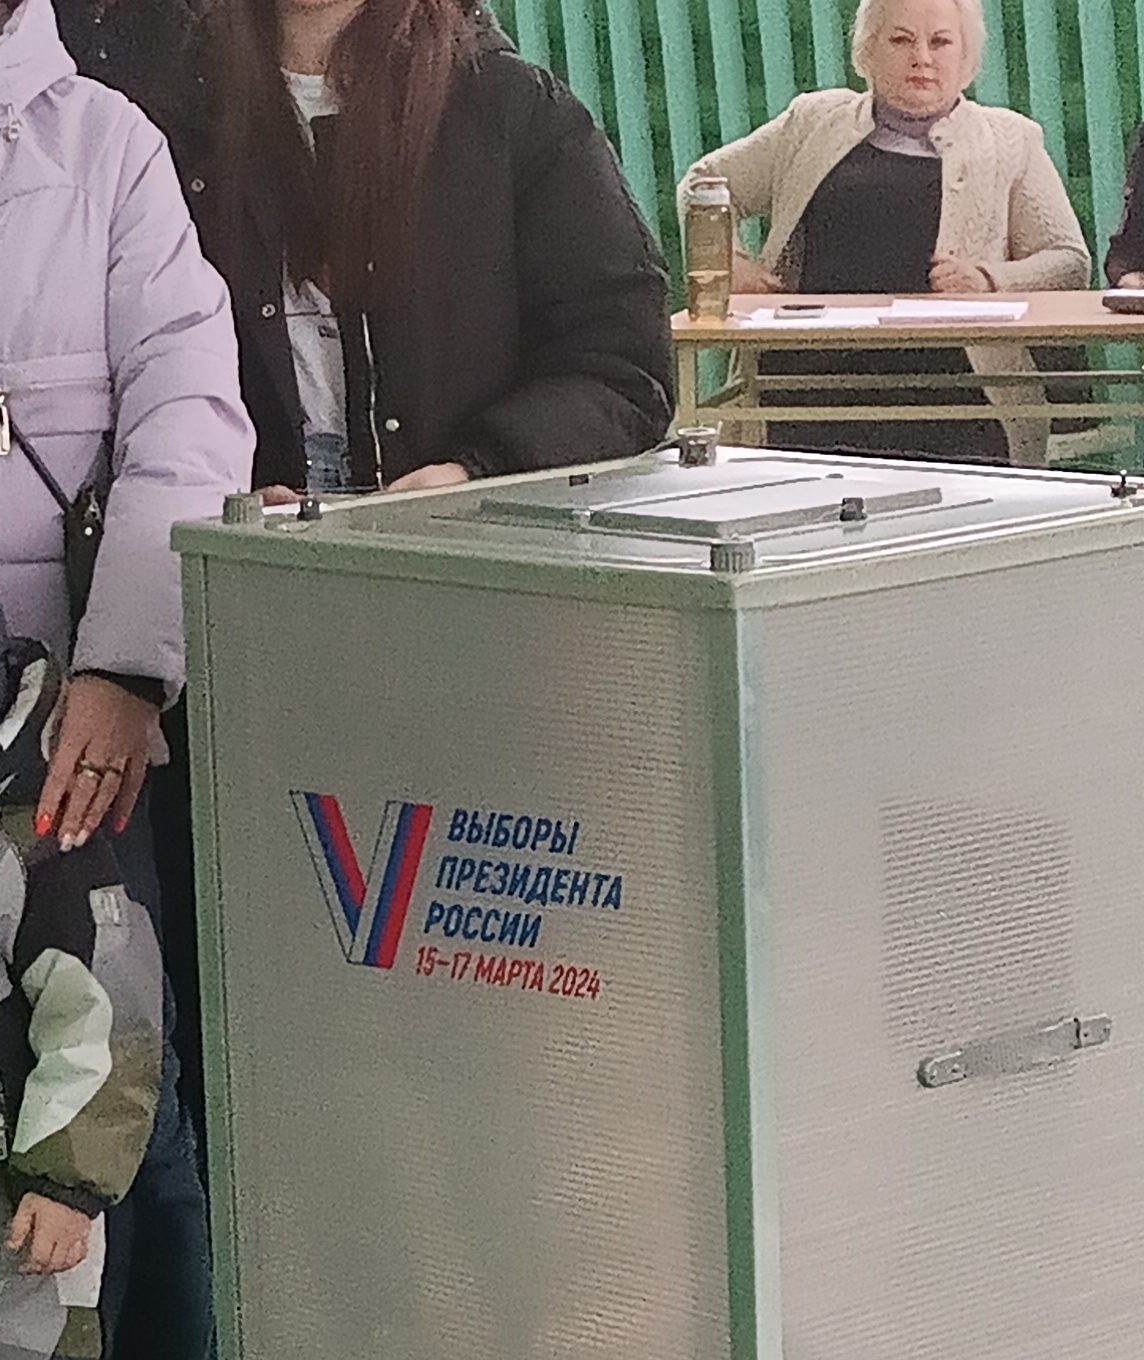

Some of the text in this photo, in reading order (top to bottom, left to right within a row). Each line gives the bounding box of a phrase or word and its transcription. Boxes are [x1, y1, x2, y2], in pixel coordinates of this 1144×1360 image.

[447, 808, 580, 855] ВЫБОРЫ
[434, 855, 623, 910] ПРЕЗИДЕНТА
[423, 900, 542, 948] РОССИИ
[474, 954, 543, 992] МАРТА
[548, 967, 601, 1001] 2024
